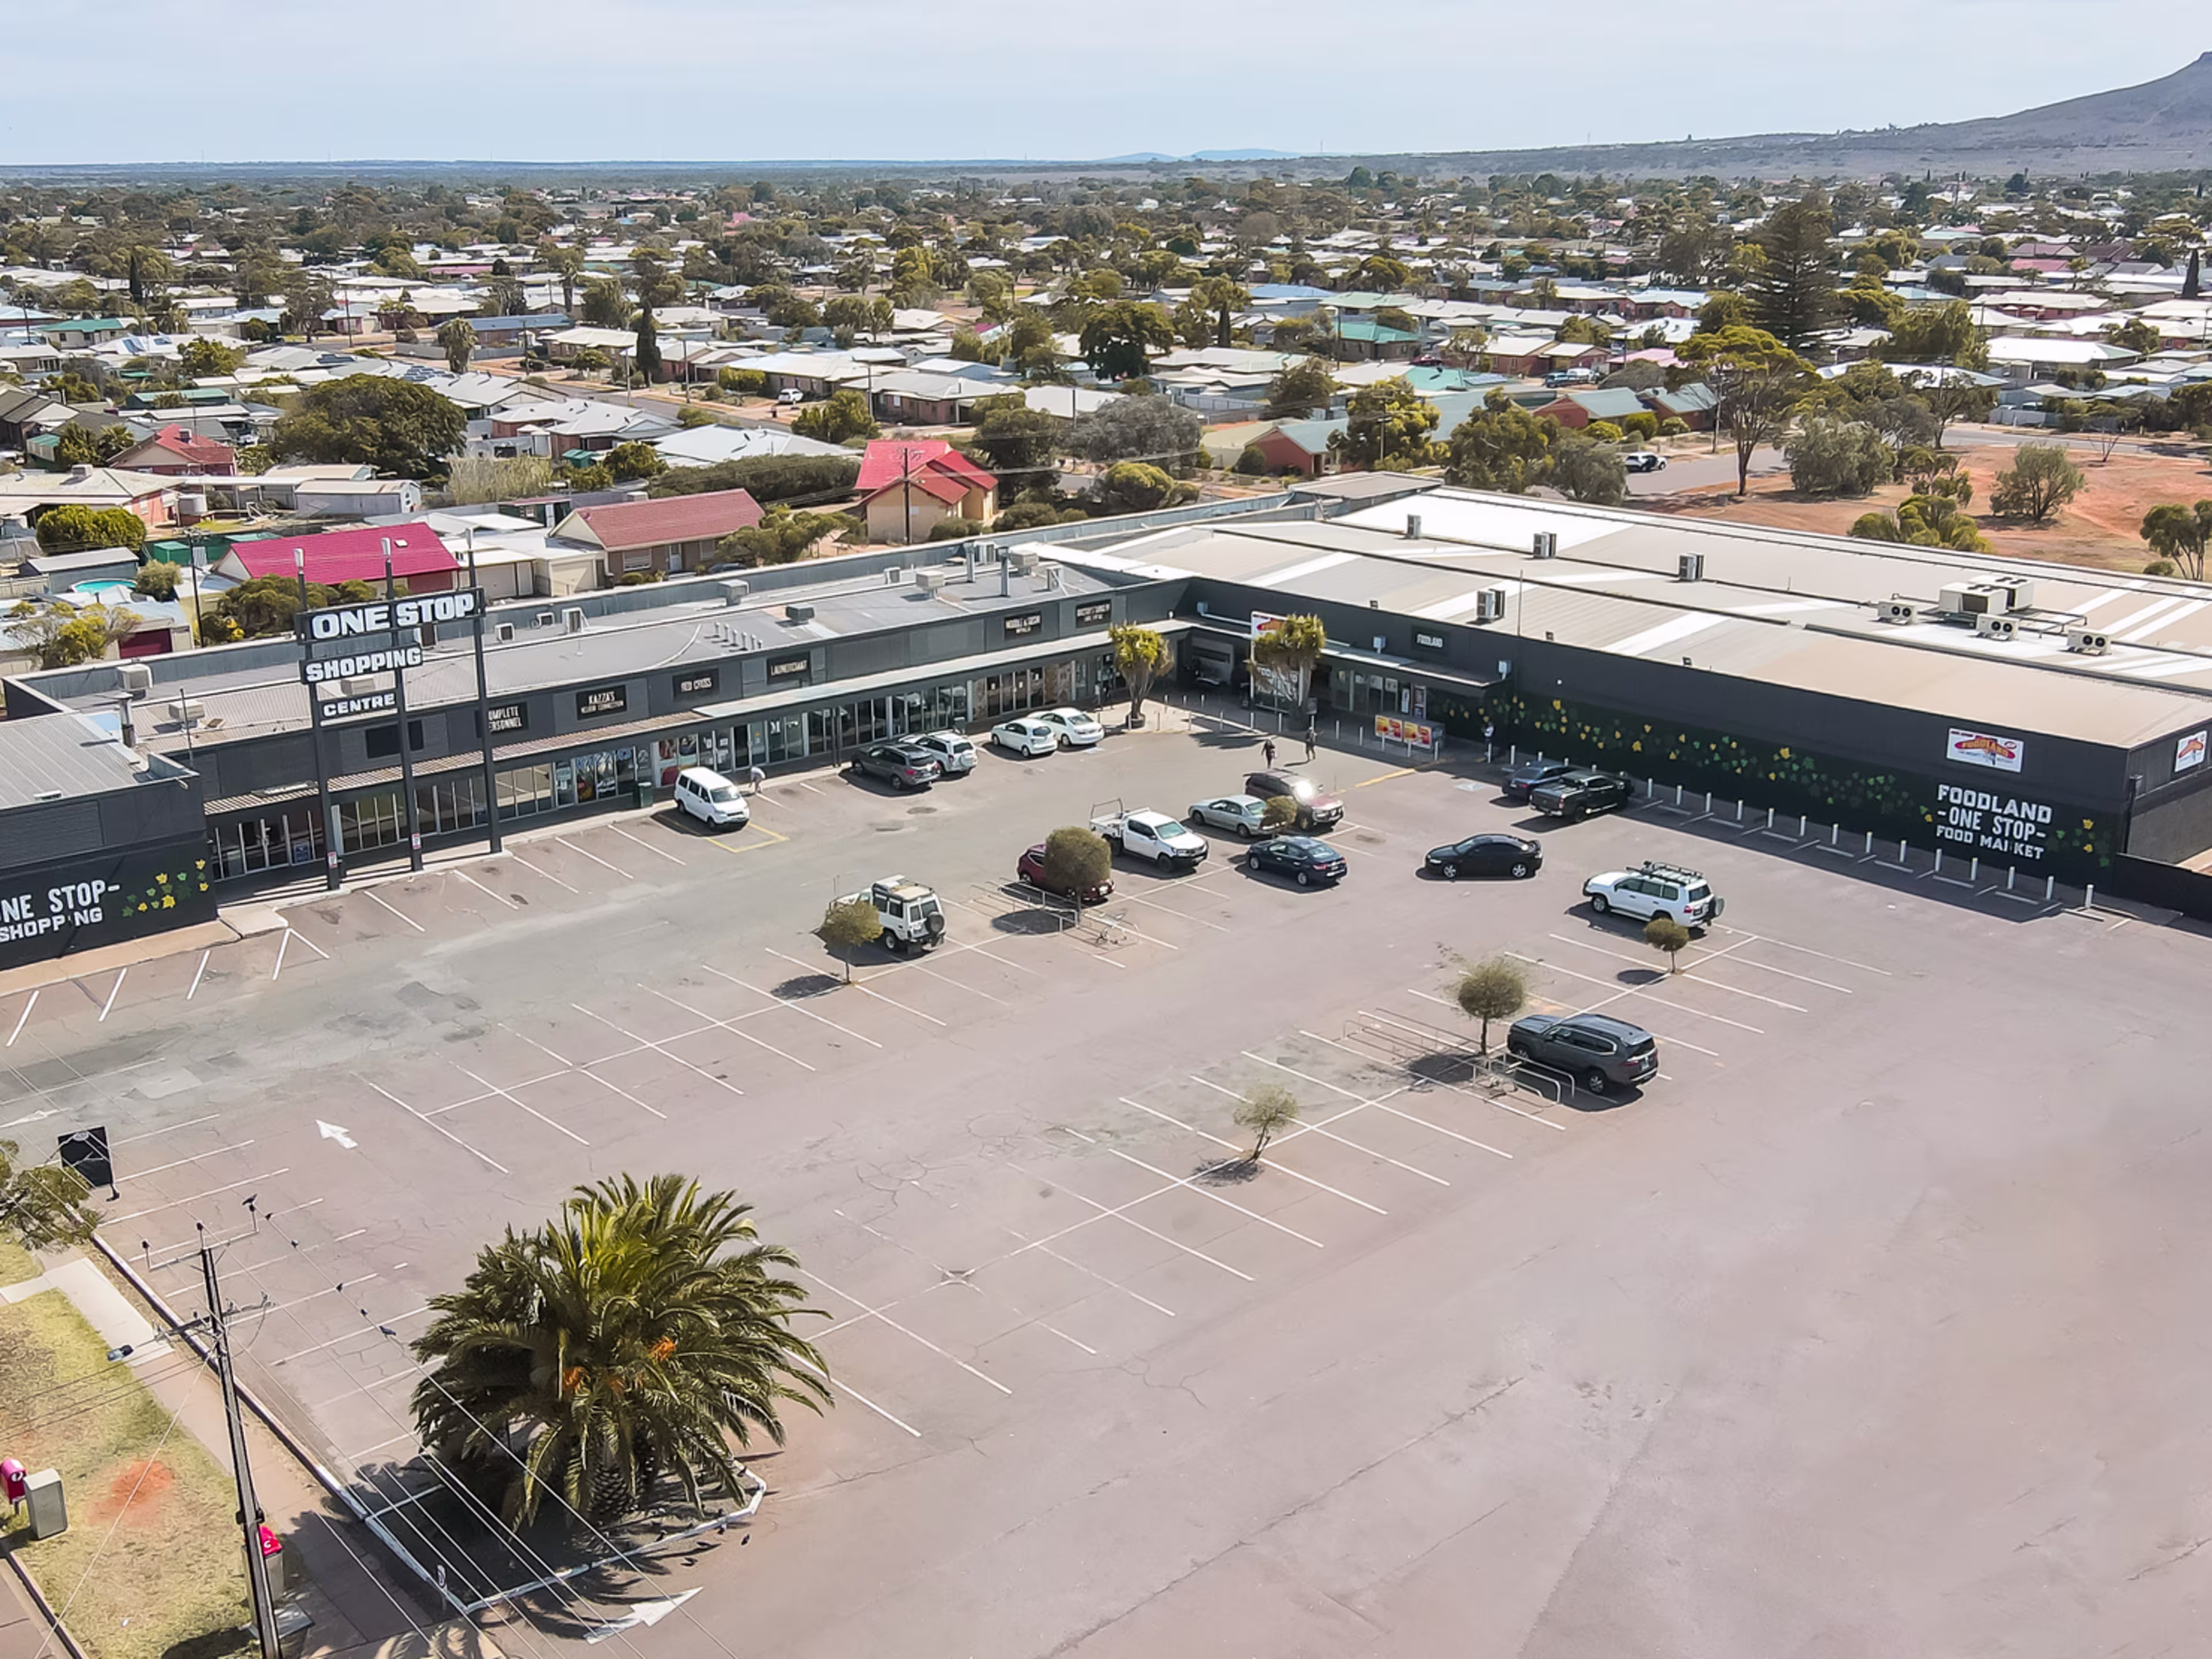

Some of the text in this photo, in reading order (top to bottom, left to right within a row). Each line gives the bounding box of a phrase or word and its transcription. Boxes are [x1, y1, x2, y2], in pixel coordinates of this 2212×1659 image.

[312, 593, 475, 639] ONE STOP
[306, 647, 422, 682] SHOPPING
[323, 693, 396, 717] CENTRE
[488, 706, 518, 721] OMPLETE
[488, 717, 522, 732] ERSONNEL
[1937, 784, 2052, 824] FOODLAND
[1936, 825, 1974, 844] FOOD
[0, 894, 35, 923] NE
[0, 907, 103, 942] SHOPPNG
